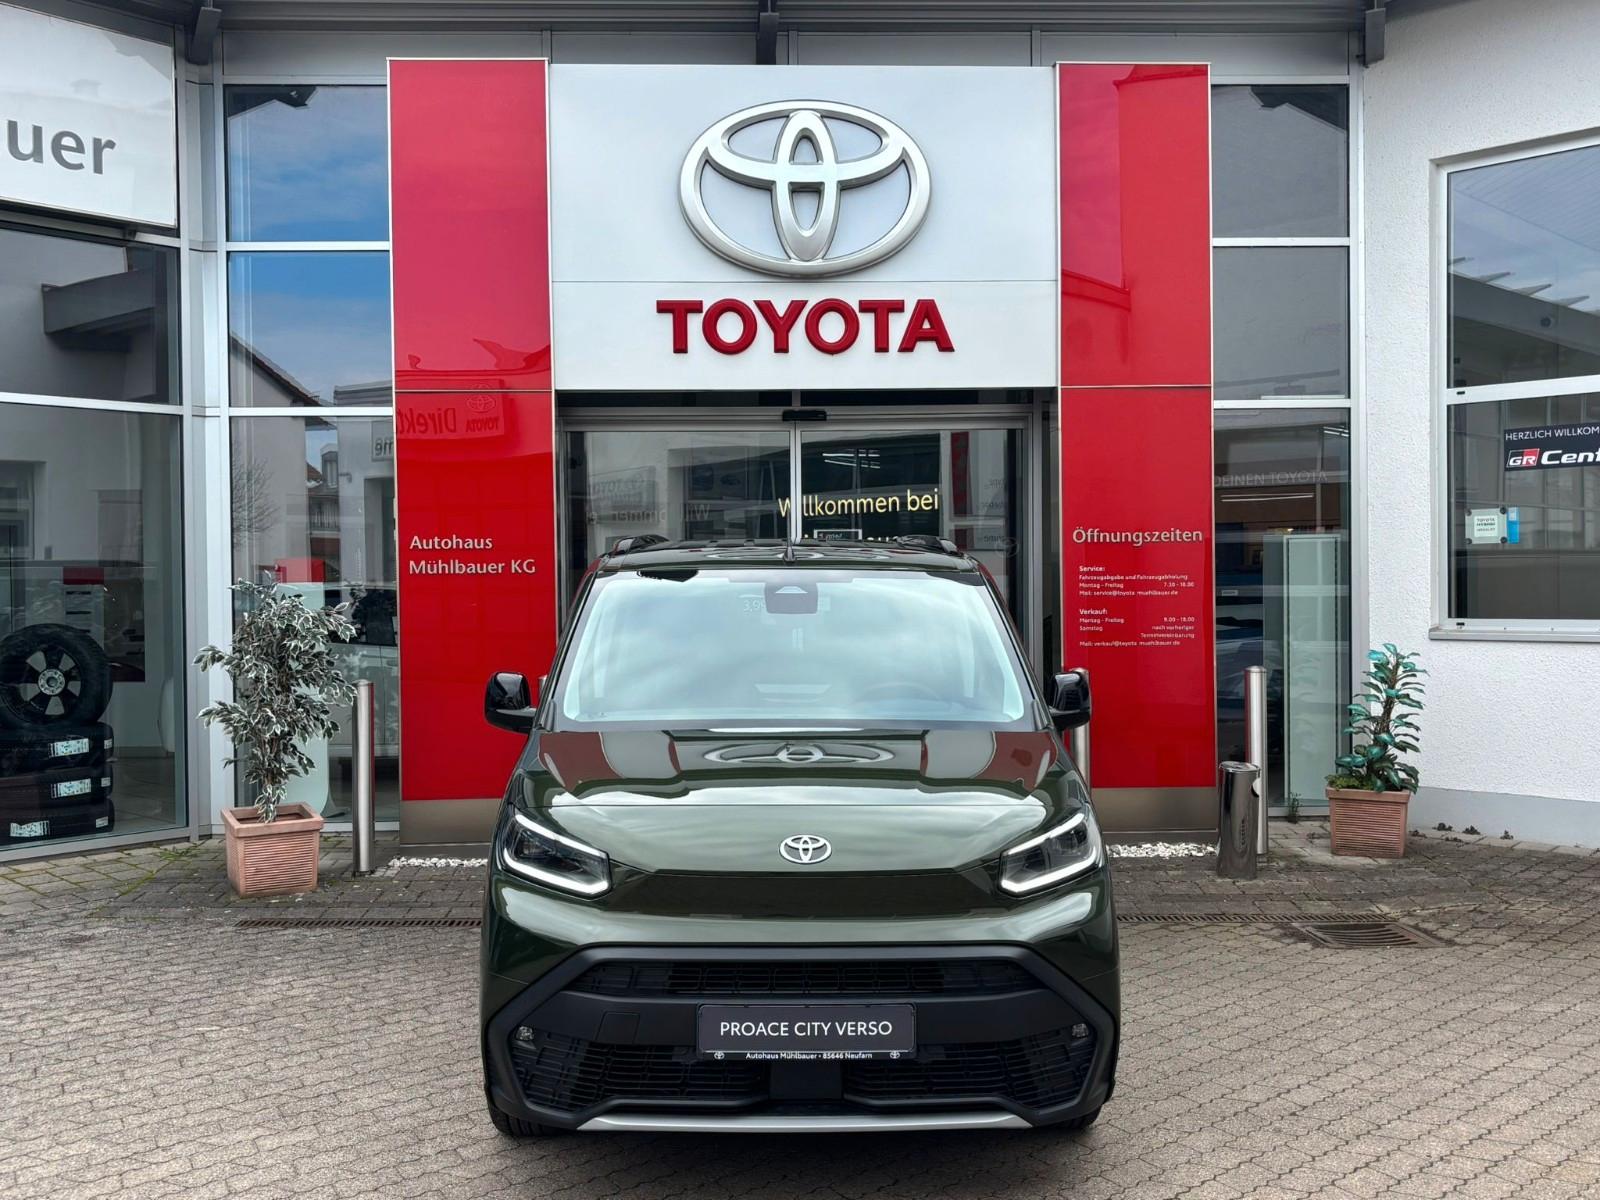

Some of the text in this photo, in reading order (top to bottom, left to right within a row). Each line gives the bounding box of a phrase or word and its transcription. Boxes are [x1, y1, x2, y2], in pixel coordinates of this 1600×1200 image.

[7, 119, 116, 175] uer
[656, 297, 955, 355] TOYOTA
[1505, 430, 1552, 441] HERZLICH
[1508, 455, 1537, 467] GR
[1270, 470, 1329, 485] TOYOTA
[778, 487, 940, 518] Wllkommen bei
[409, 534, 493, 550] Autohaus
[1072, 526, 1203, 547] Öffnungszeiten
[409, 559, 536, 575] Mühlbauer KG
[720, 1021, 892, 1037] PROACE CITY VERSO
[746, 1052, 779, 1060] Autohaus
[780, 1051, 818, 1060] Mühlbauer
